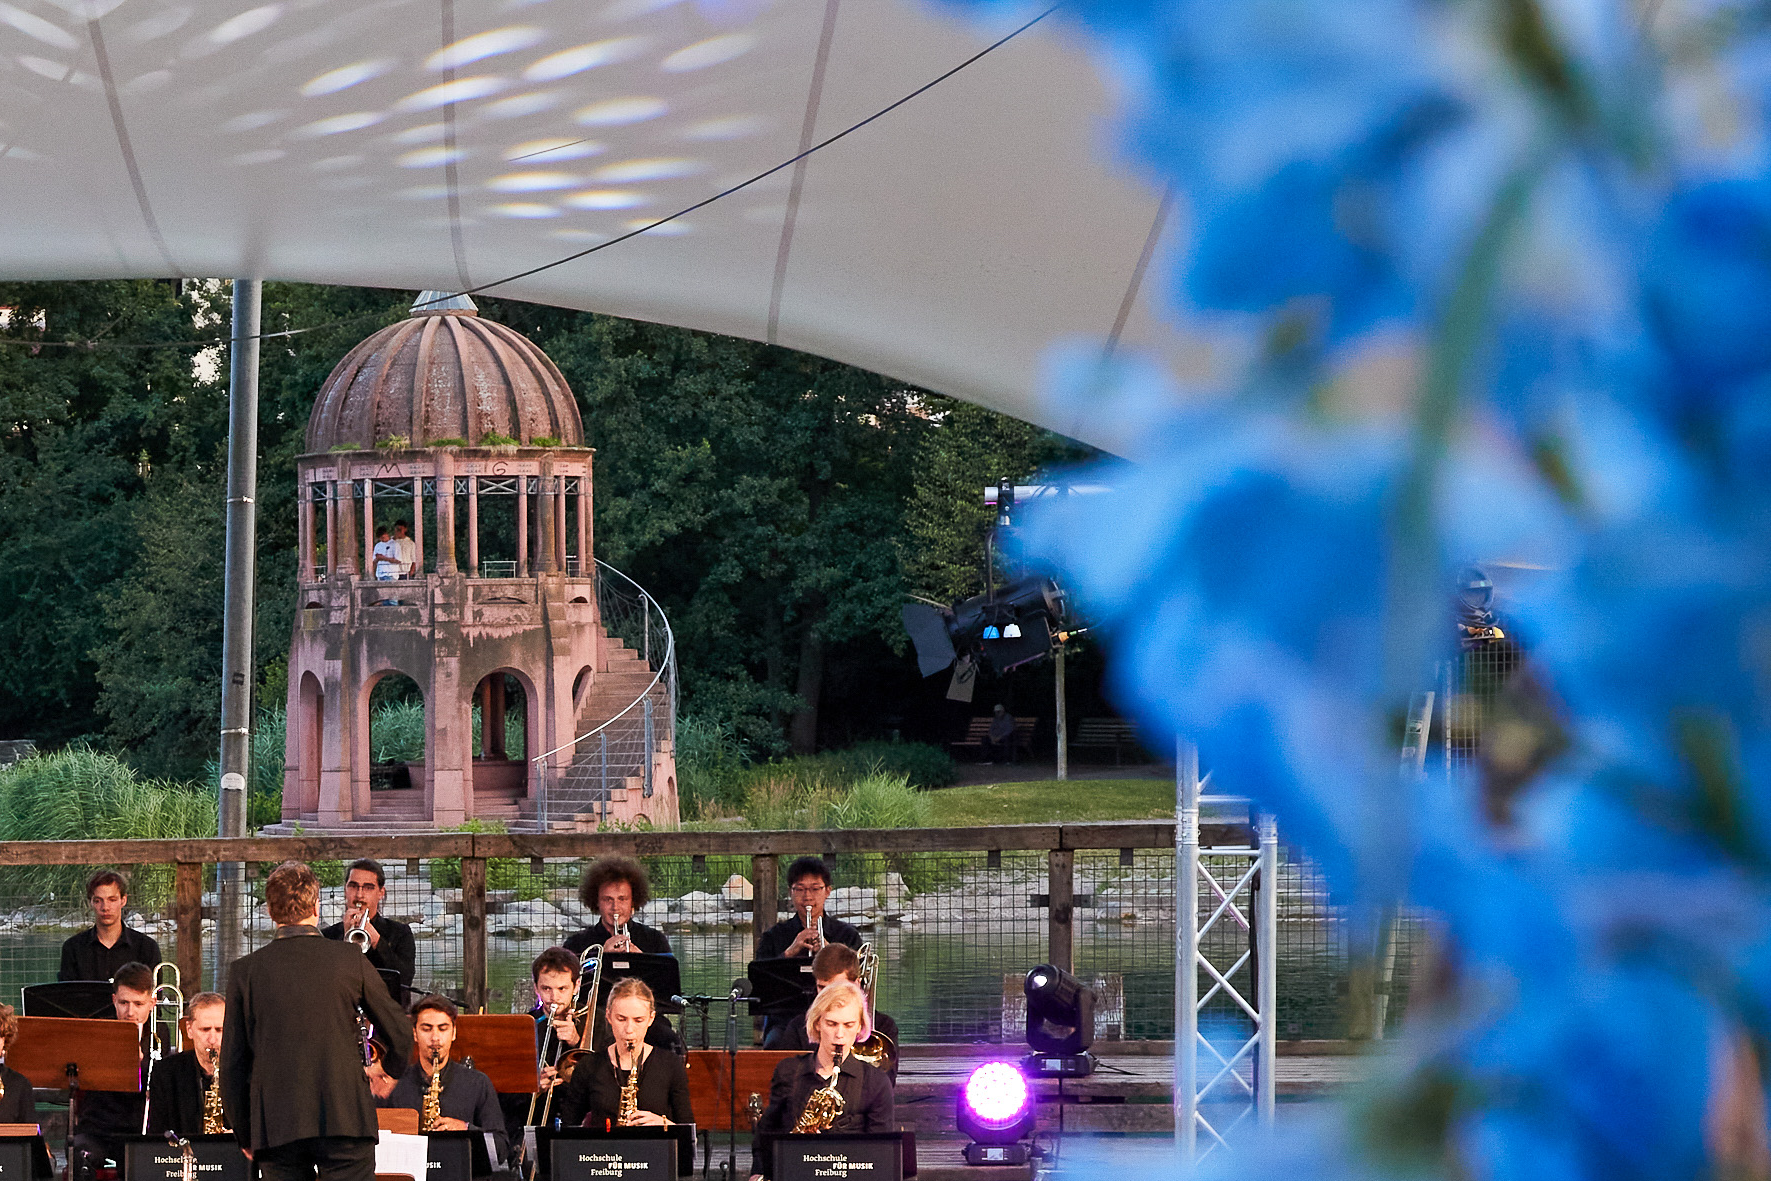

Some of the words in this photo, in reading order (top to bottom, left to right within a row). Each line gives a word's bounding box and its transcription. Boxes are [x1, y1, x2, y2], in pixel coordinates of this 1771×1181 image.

[579, 1153, 623, 1162] Hochschule
[803, 1153, 848, 1162] Hochschule
[608, 1161, 623, 1169] FÜR
[832, 1161, 847, 1170] FÜR
[848, 1162, 874, 1170] MUSIK
[590, 1168, 623, 1177] Freiburg
[814, 1168, 848, 1178] Freiburg
